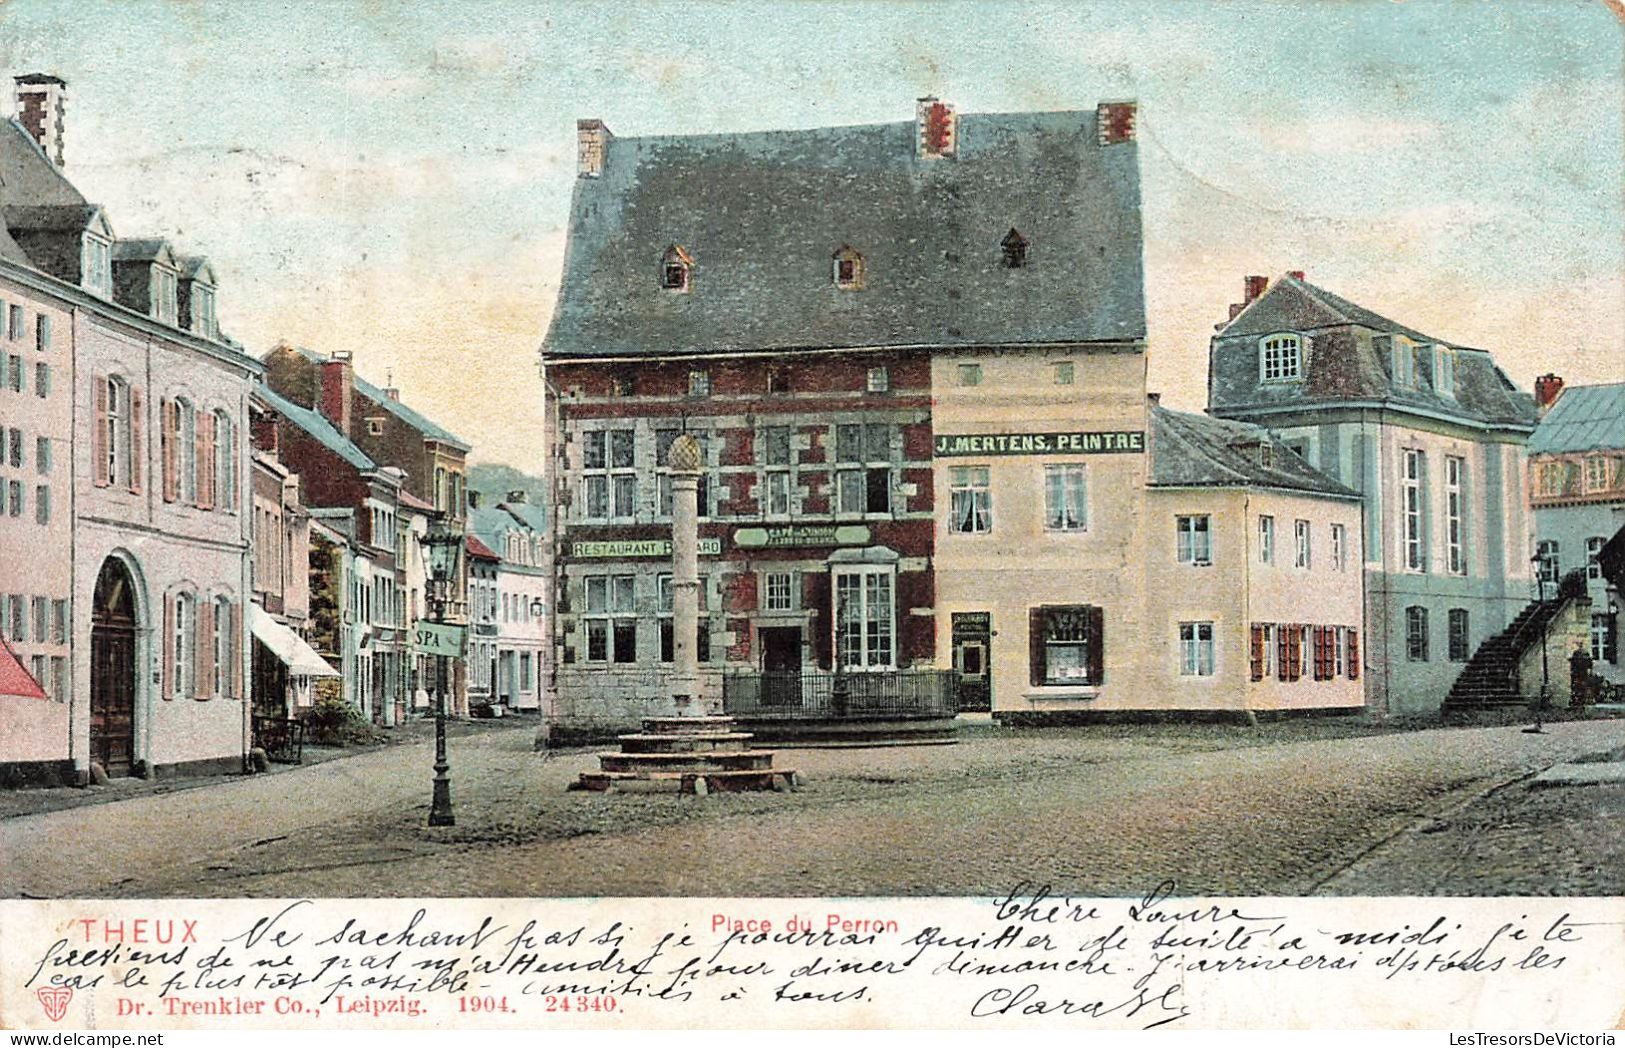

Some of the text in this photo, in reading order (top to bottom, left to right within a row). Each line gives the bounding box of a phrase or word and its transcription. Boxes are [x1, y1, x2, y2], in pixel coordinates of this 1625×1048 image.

[1057, 433, 1142, 450] PEINTRE
[574, 542, 656, 556] RESTAURANT
[415, 630, 440, 647] SPA
[80, 919, 199, 944] THEUX
[712, 914, 899, 933] Place du Perron
[505, 919, 586, 966] pas
[707, 926, 885, 964] pourrai
[1079, 925, 1127, 952] de
[1335, 916, 1463, 946] midi
[113, 967, 149, 988] le
[196, 946, 234, 968] de
[250, 954, 293, 968] ne
[311, 950, 403, 982] pas
[668, 956, 775, 988] pour
[1511, 946, 1568, 970] les
[117, 998, 153, 1016] Dr.
[163, 996, 266, 1016] Trenkler
[274, 997, 321, 1018] Co.,
[334, 995, 428, 1017] Leipzig.
[458, 996, 517, 1014] 1904.
